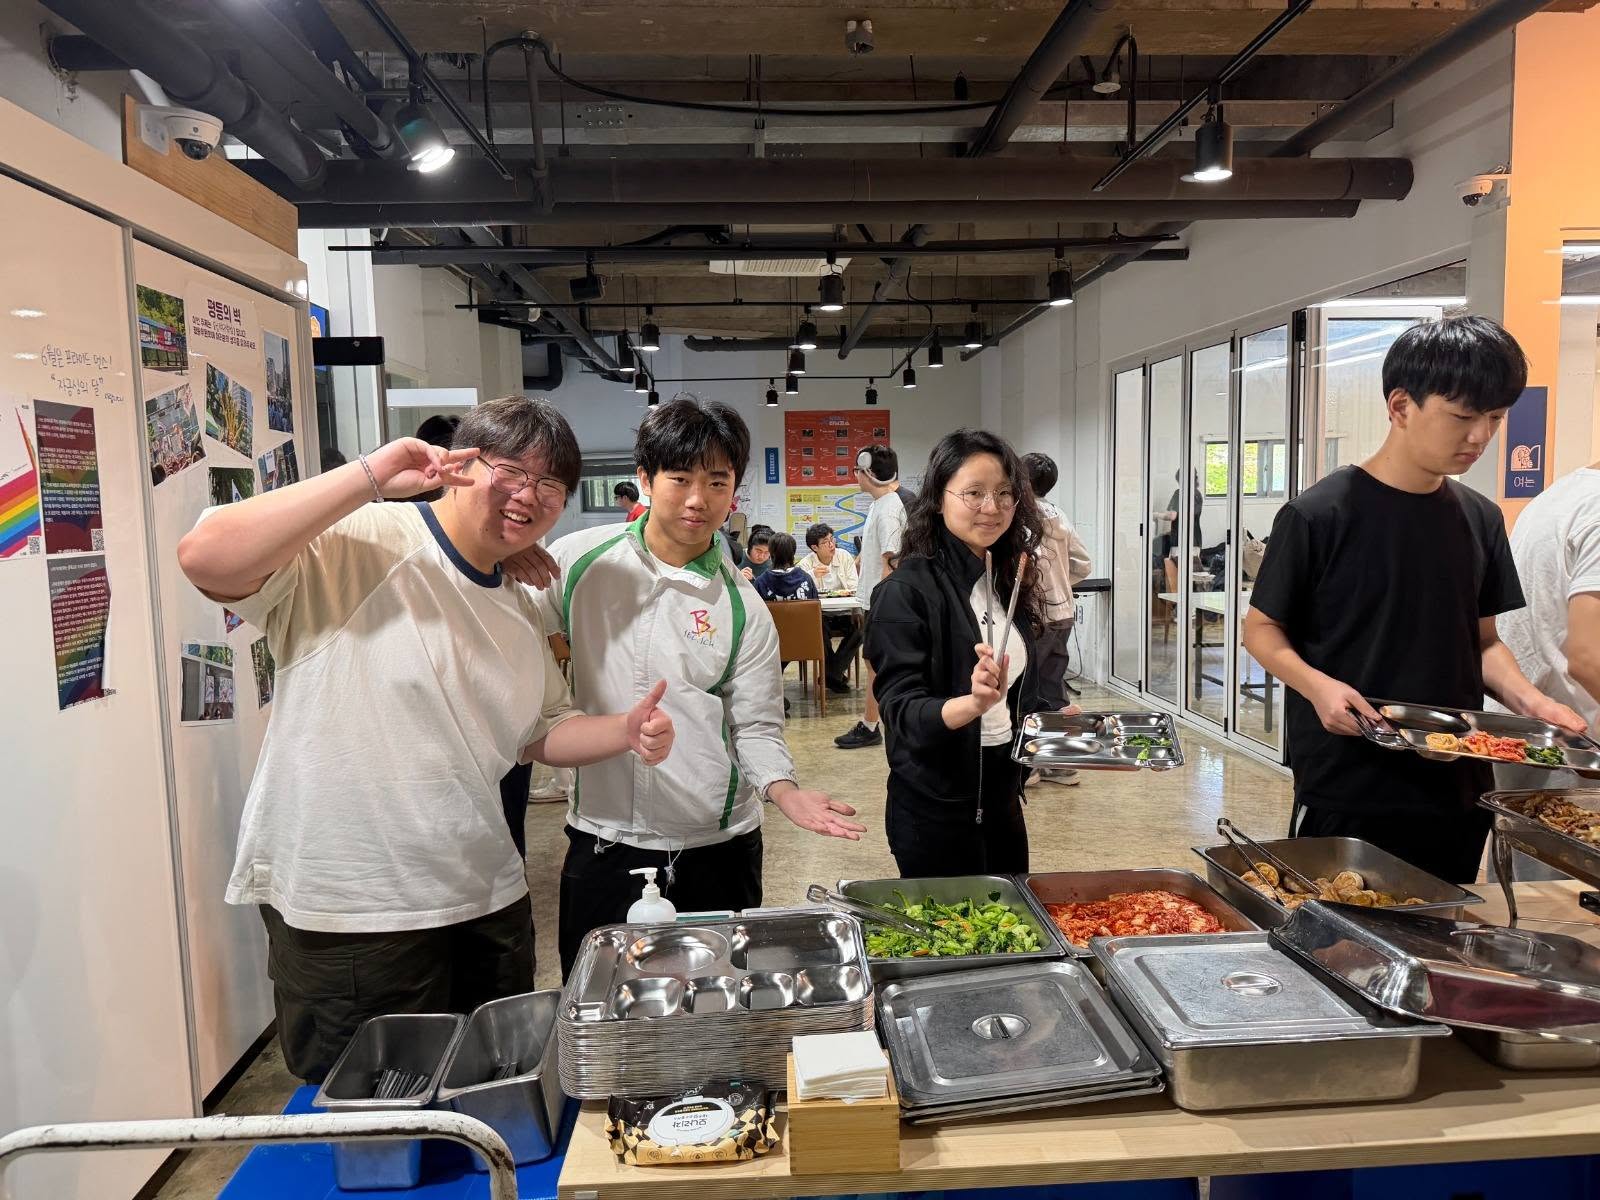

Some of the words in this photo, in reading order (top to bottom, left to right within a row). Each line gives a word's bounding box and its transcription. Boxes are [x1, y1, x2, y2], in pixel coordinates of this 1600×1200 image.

[207, 299, 231, 323] 평등의
[233, 307, 241, 326] 벽
[672, 1118, 707, 1129] 모나리자
